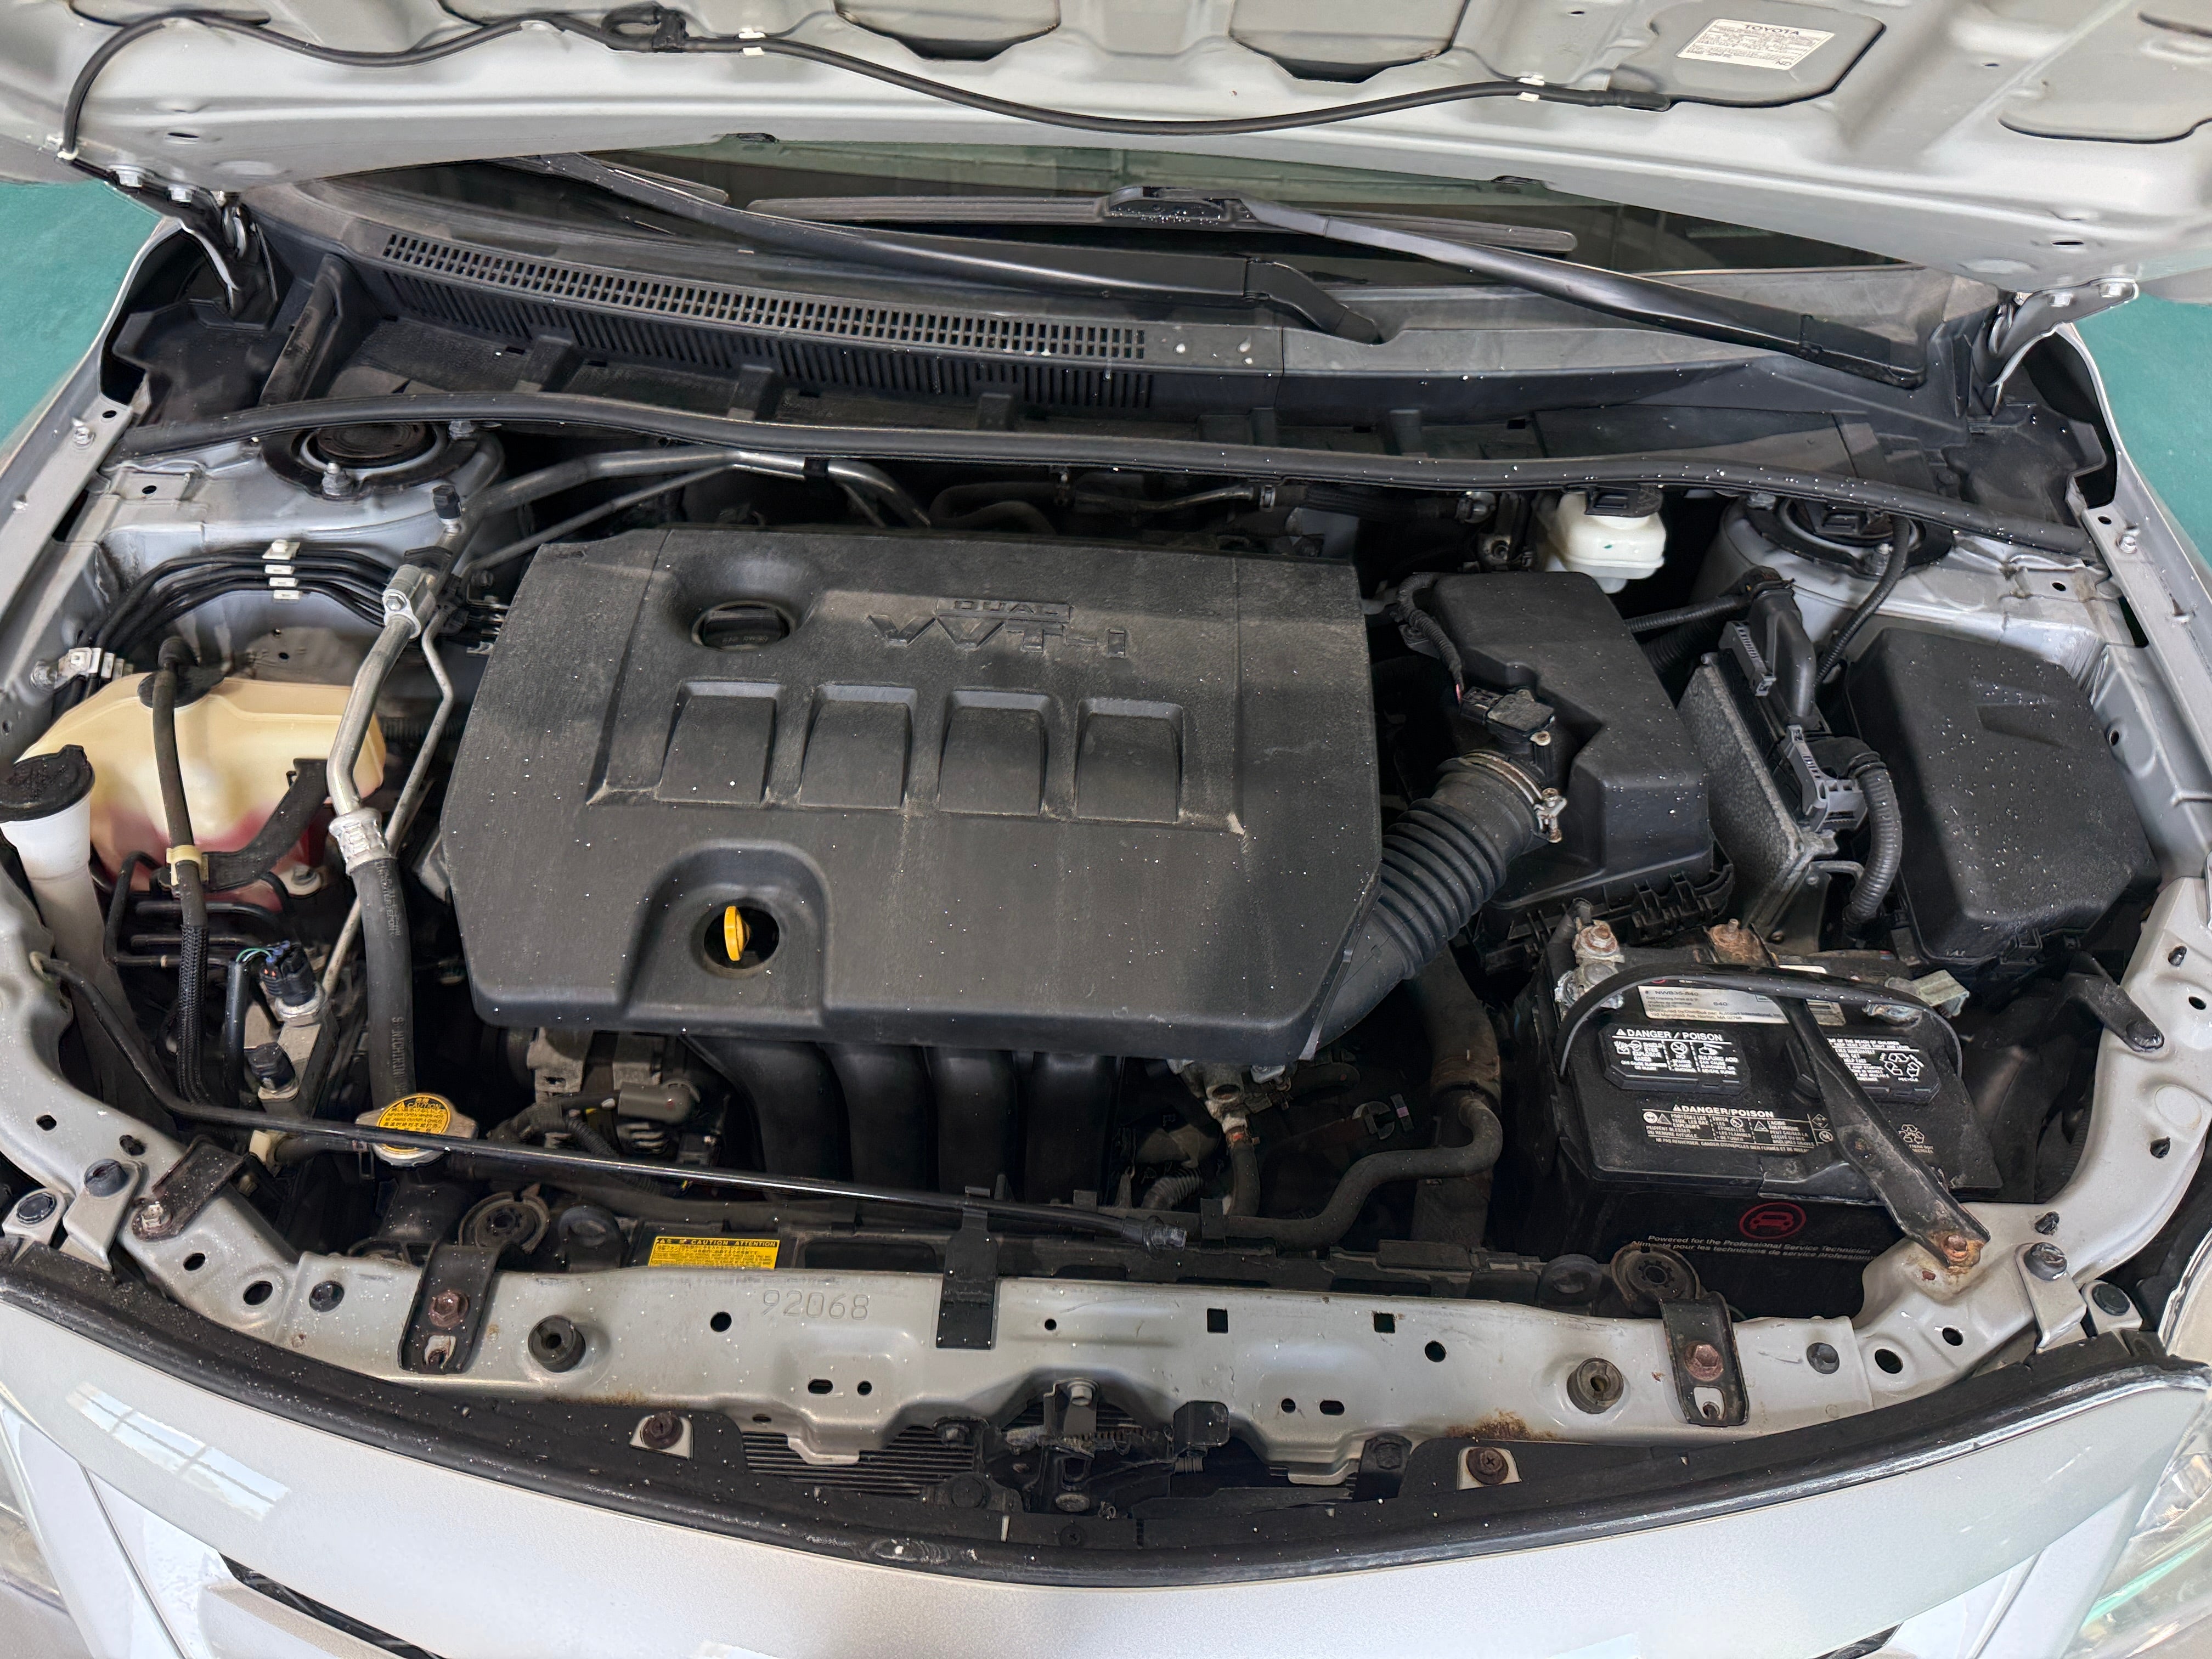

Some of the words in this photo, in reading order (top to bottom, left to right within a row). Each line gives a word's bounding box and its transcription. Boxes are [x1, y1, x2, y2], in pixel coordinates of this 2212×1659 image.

[1745, 24, 1799, 35] TOYOTA
[1626, 1029, 1672, 1039] DANGER
[1681, 1032, 1723, 1041] POISON
[1680, 1105, 1774, 1118] DANGER/POISON
[1648, 1235, 1689, 1244] Powered
[1723, 1240, 1782, 1249] Professional
[1822, 1245, 1871, 1254] Technician
[1713, 1245, 1766, 1254] techniciens
[761, 1289, 870, 1321] 92068
